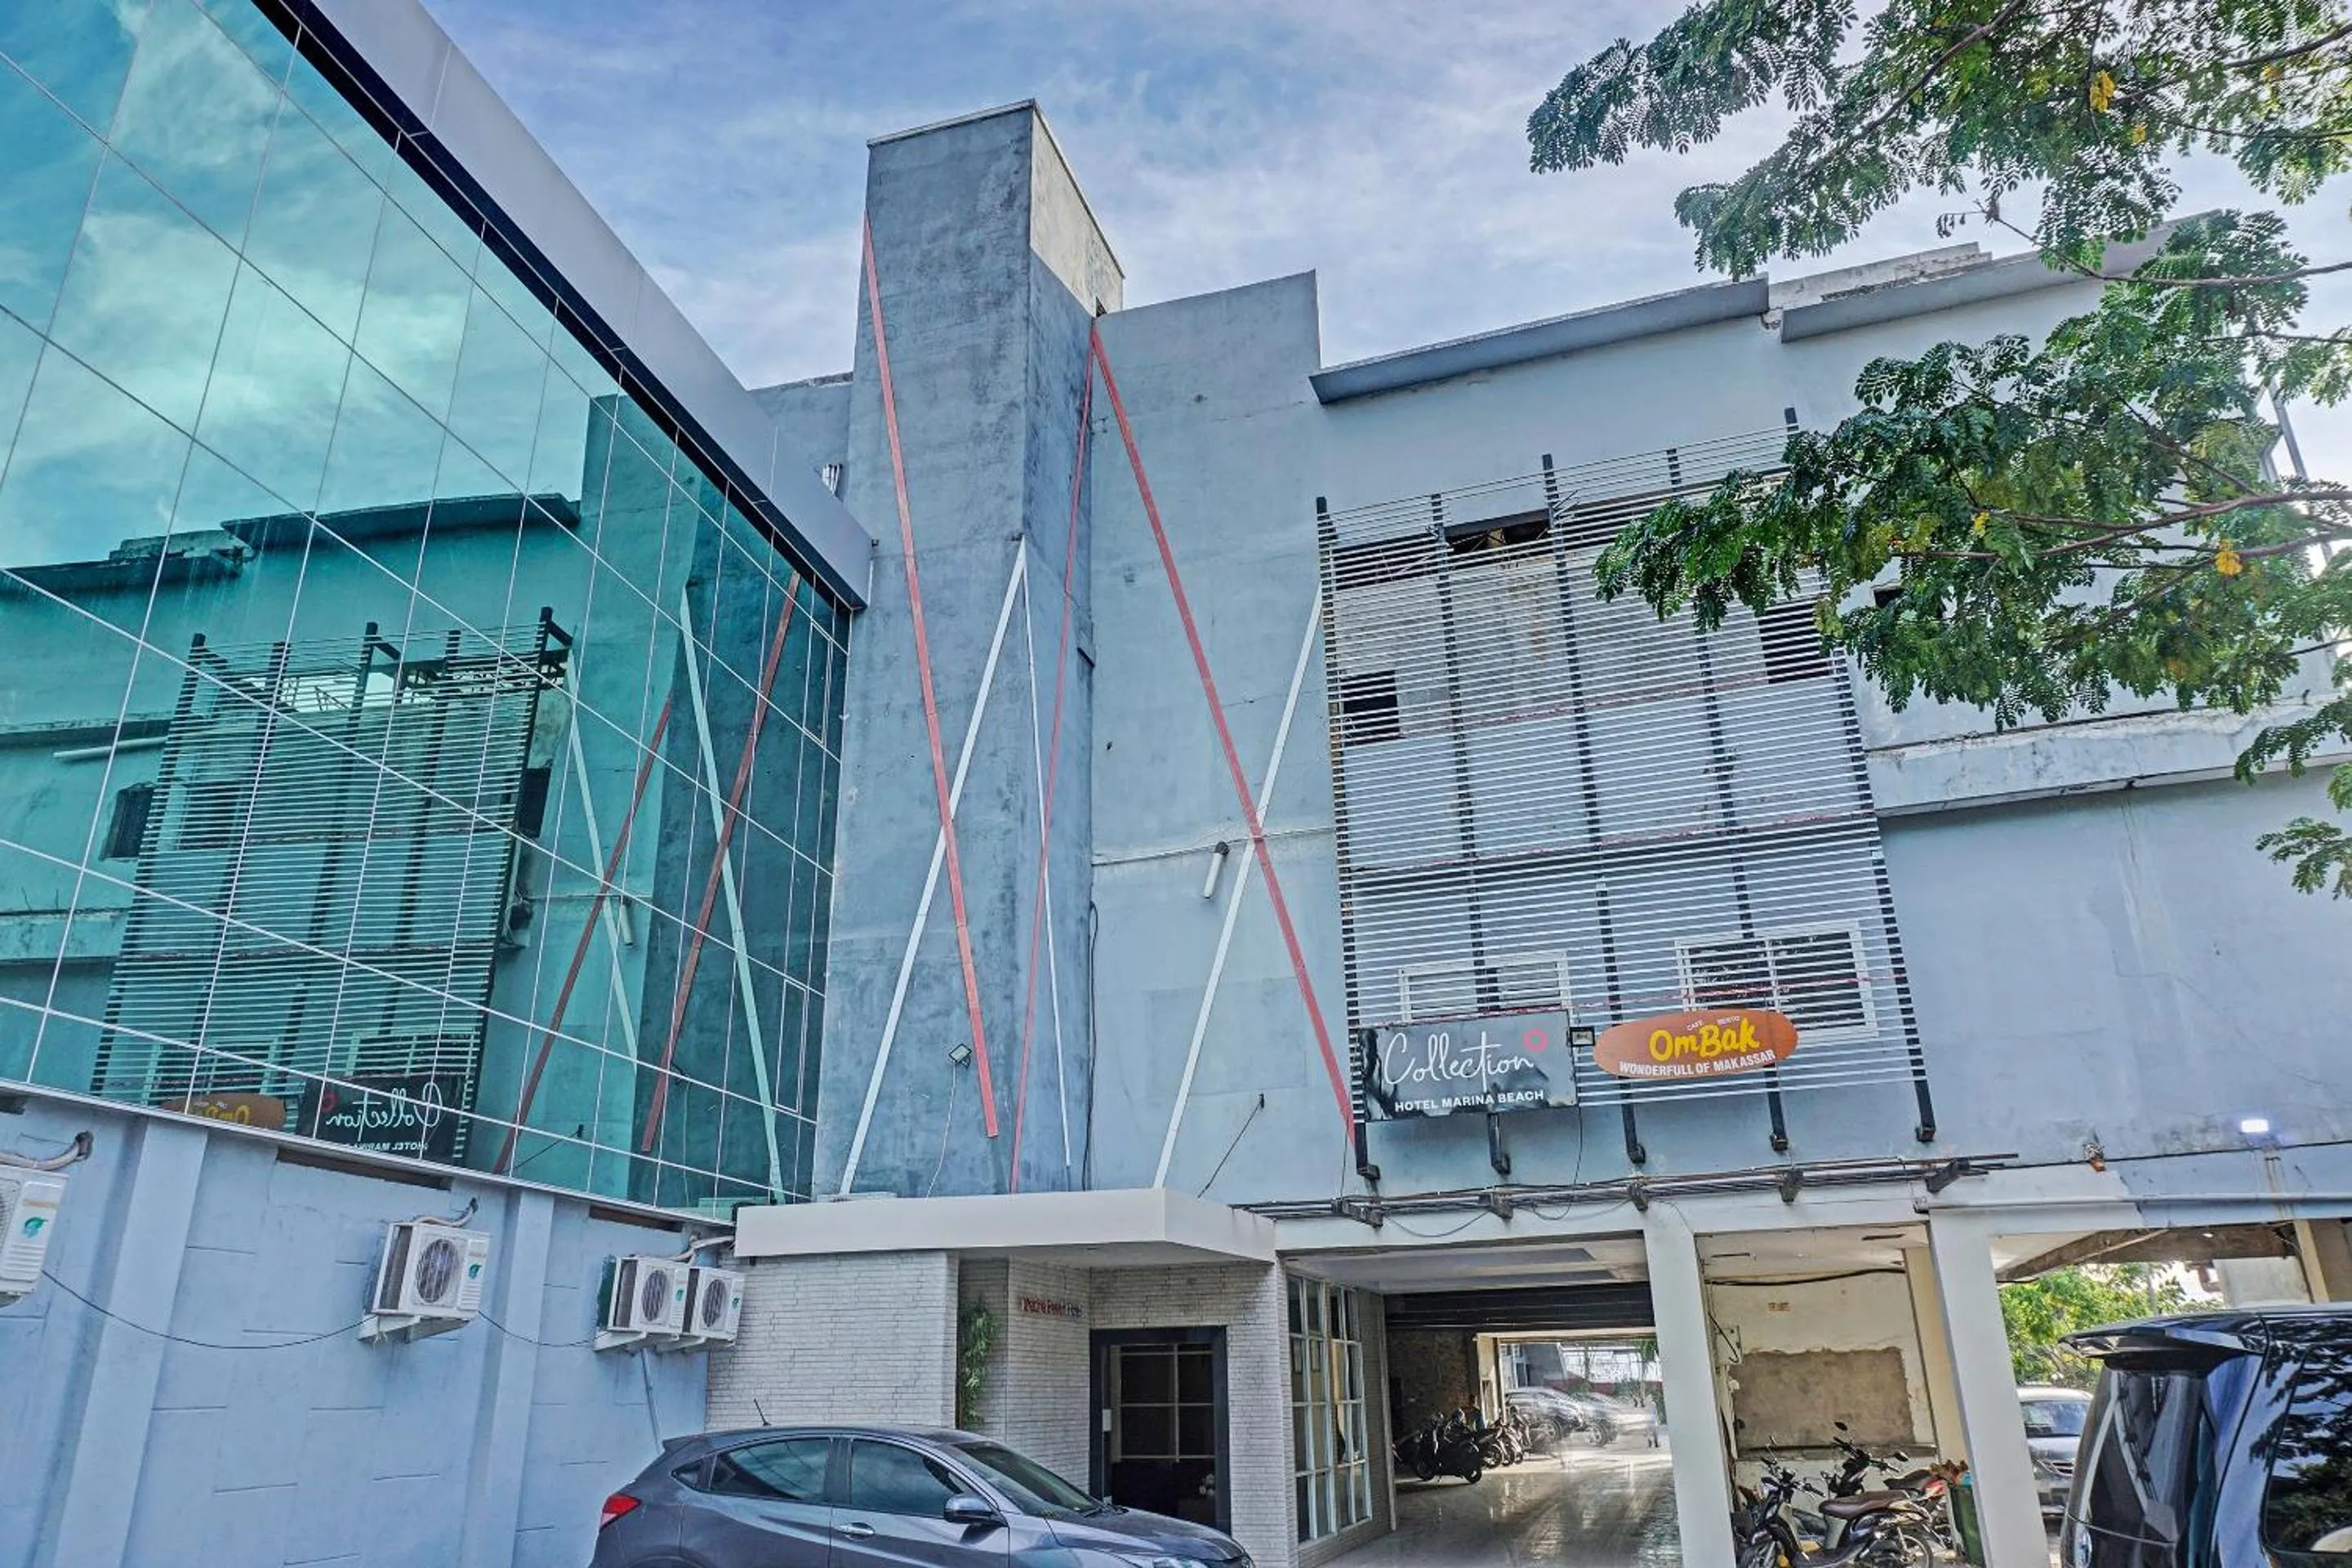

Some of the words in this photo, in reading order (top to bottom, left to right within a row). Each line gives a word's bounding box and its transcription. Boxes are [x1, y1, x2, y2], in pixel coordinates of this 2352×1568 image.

[1649, 1018, 1761, 1062] OmBak
[1384, 1031, 1535, 1093] Collection
[1619, 1061, 1694, 1076] WONDERFULL
[1695, 1061, 1710, 1074] OF
[1713, 1049, 1776, 1073] MAKASSAR
[1394, 1098, 1439, 1112] HOTEL
[1441, 1093, 1495, 1108] MARINA
[1497, 1089, 1544, 1102] BEACH
